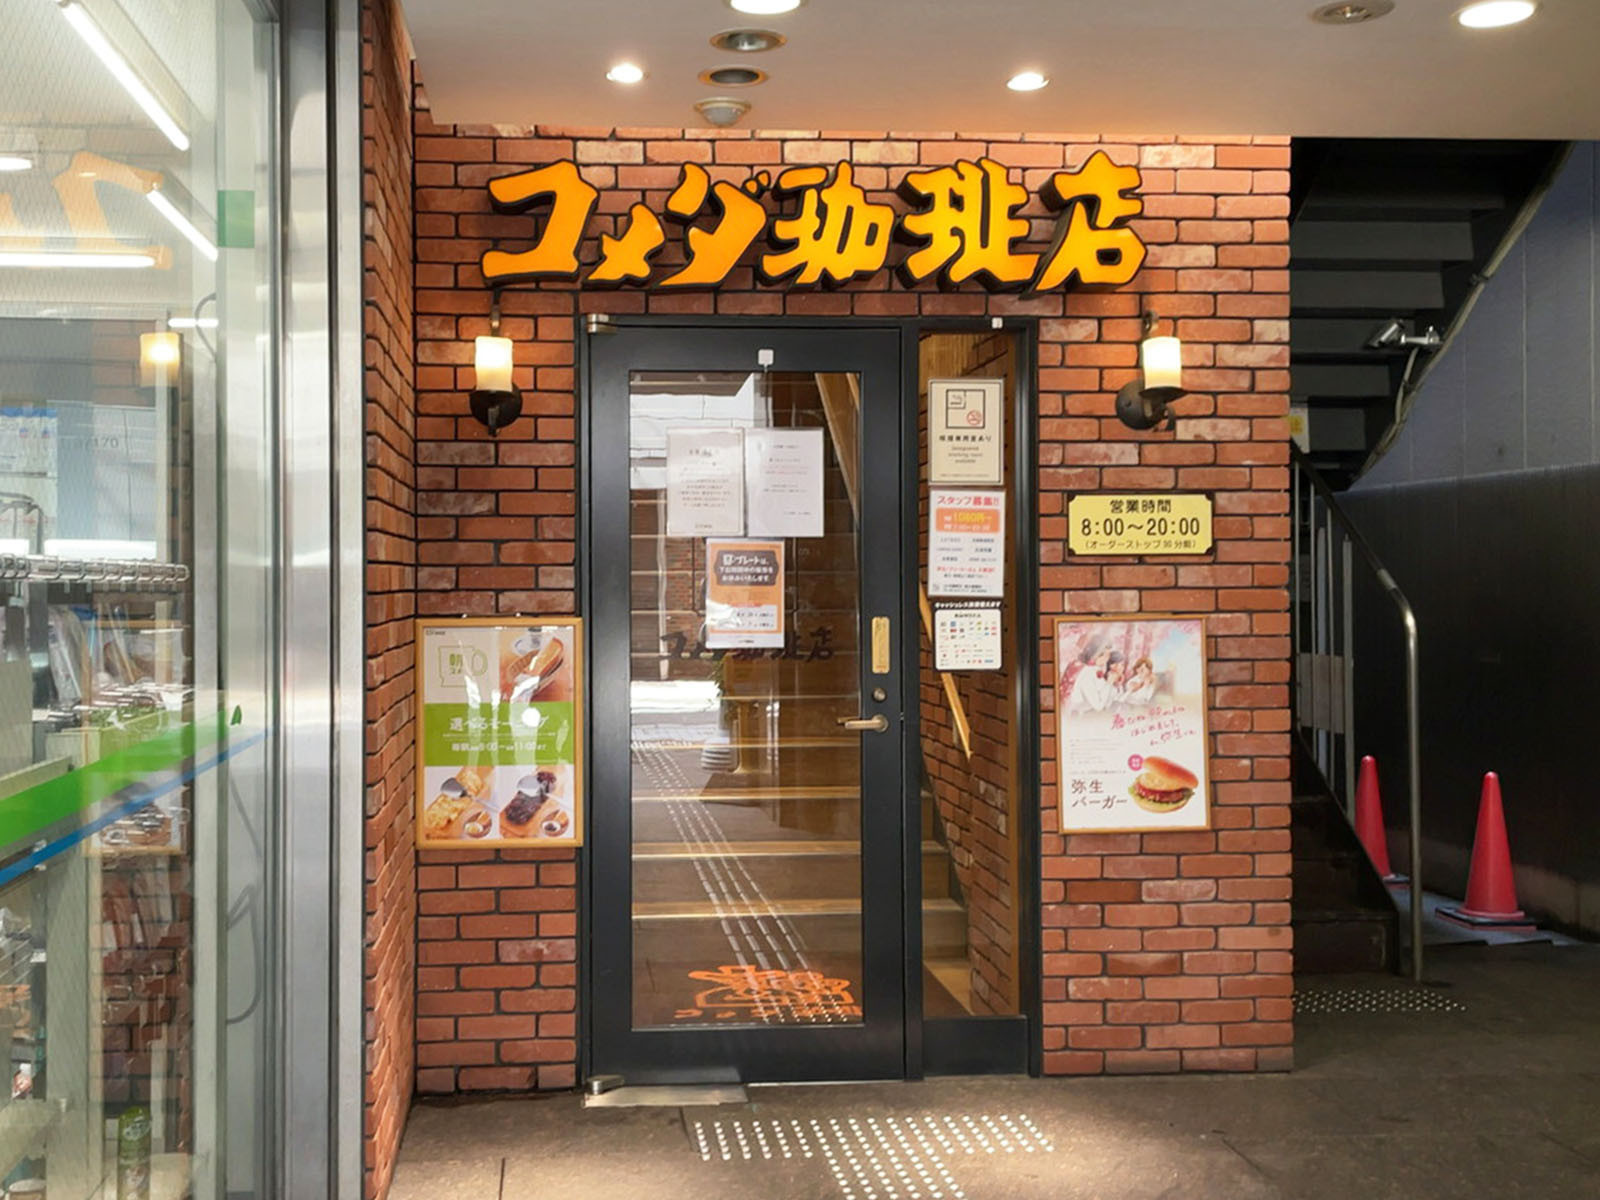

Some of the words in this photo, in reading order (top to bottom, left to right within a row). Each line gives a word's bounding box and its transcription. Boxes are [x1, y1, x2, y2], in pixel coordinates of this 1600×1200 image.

[481, 150, 1147, 294] コメダ珈琲店
[1109, 499, 1172, 514] 営業時間
[1081, 517, 1200, 537] 8:00〜20:00
[1071, 779, 1104, 795] 弥生
[1071, 795, 1129, 810] バーガー
